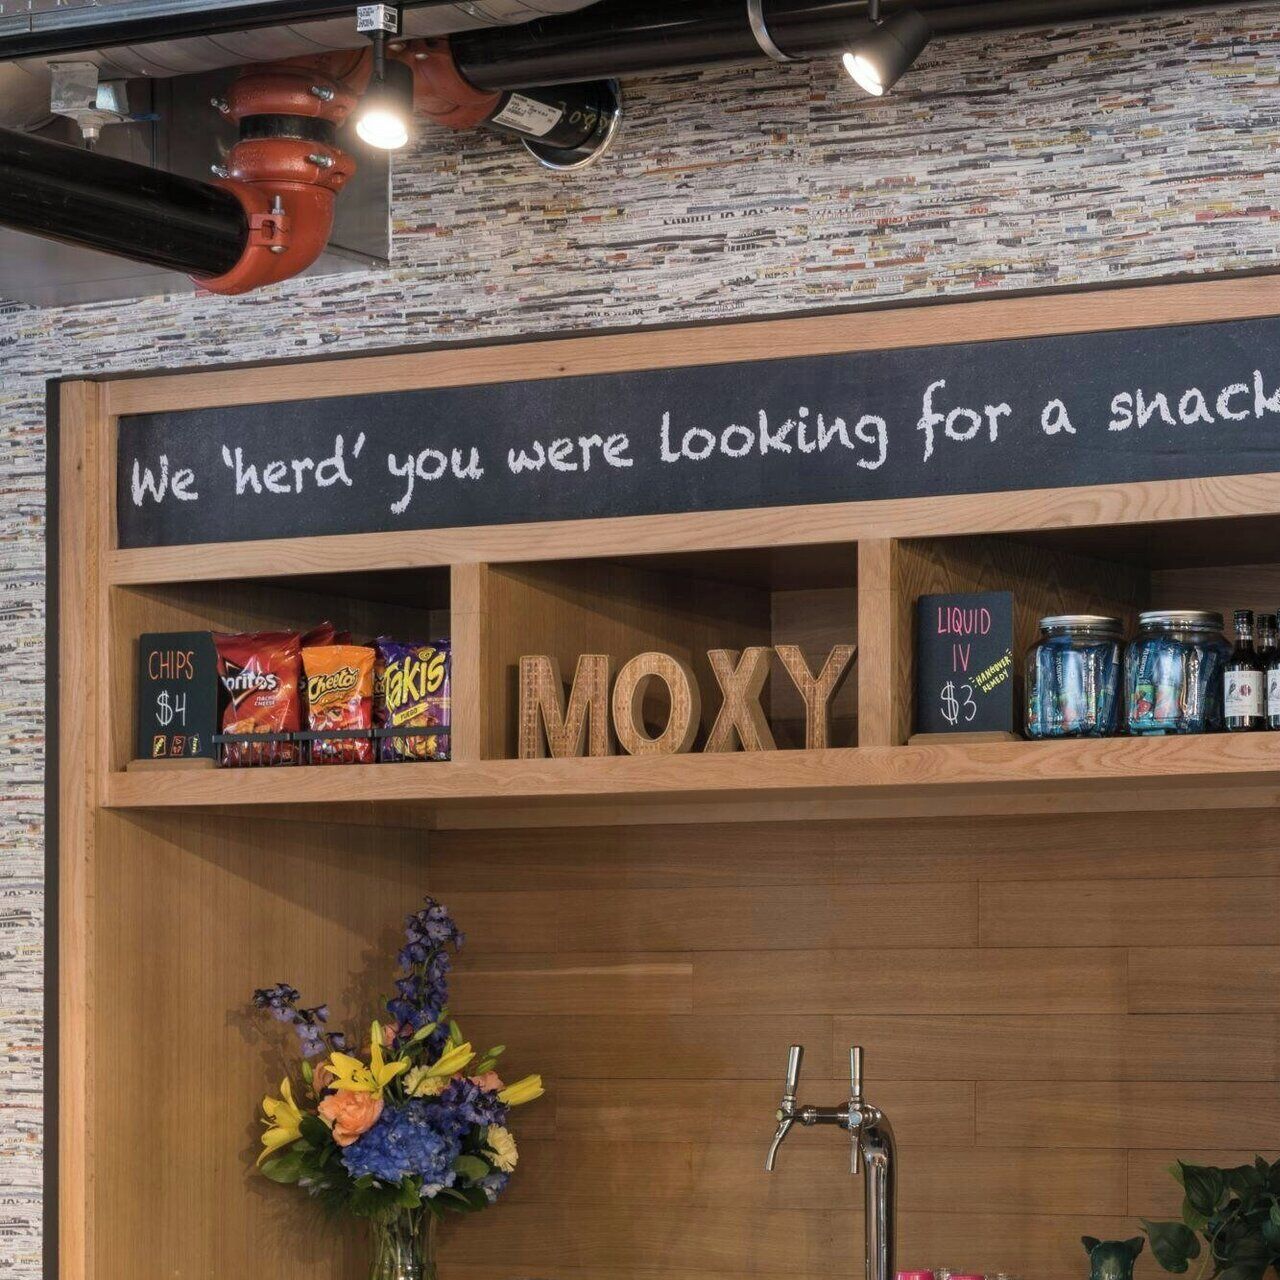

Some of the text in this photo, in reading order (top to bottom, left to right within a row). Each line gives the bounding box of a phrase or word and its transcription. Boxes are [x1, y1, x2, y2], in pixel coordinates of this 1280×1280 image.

[129, 455, 198, 508] We
[390, 442, 484, 514] you
[508, 426, 633, 477] were
[659, 406, 889, 469] looking
[917, 378, 1010, 462] for
[1040, 398, 1076, 436] a
[937, 606, 991, 636] LIQUID
[149, 651, 195, 680] CHIPS
[953, 644, 970, 672] IV
[975, 656, 1012, 686] HANGOVER
[309, 666, 359, 700] Cheeto
[386, 650, 446, 710] Takis
[982, 670, 1010, 695] REMEDY
[156, 690, 186, 726] $4
[519, 644, 857, 759] MOXY
[940, 680, 977, 727] $3
